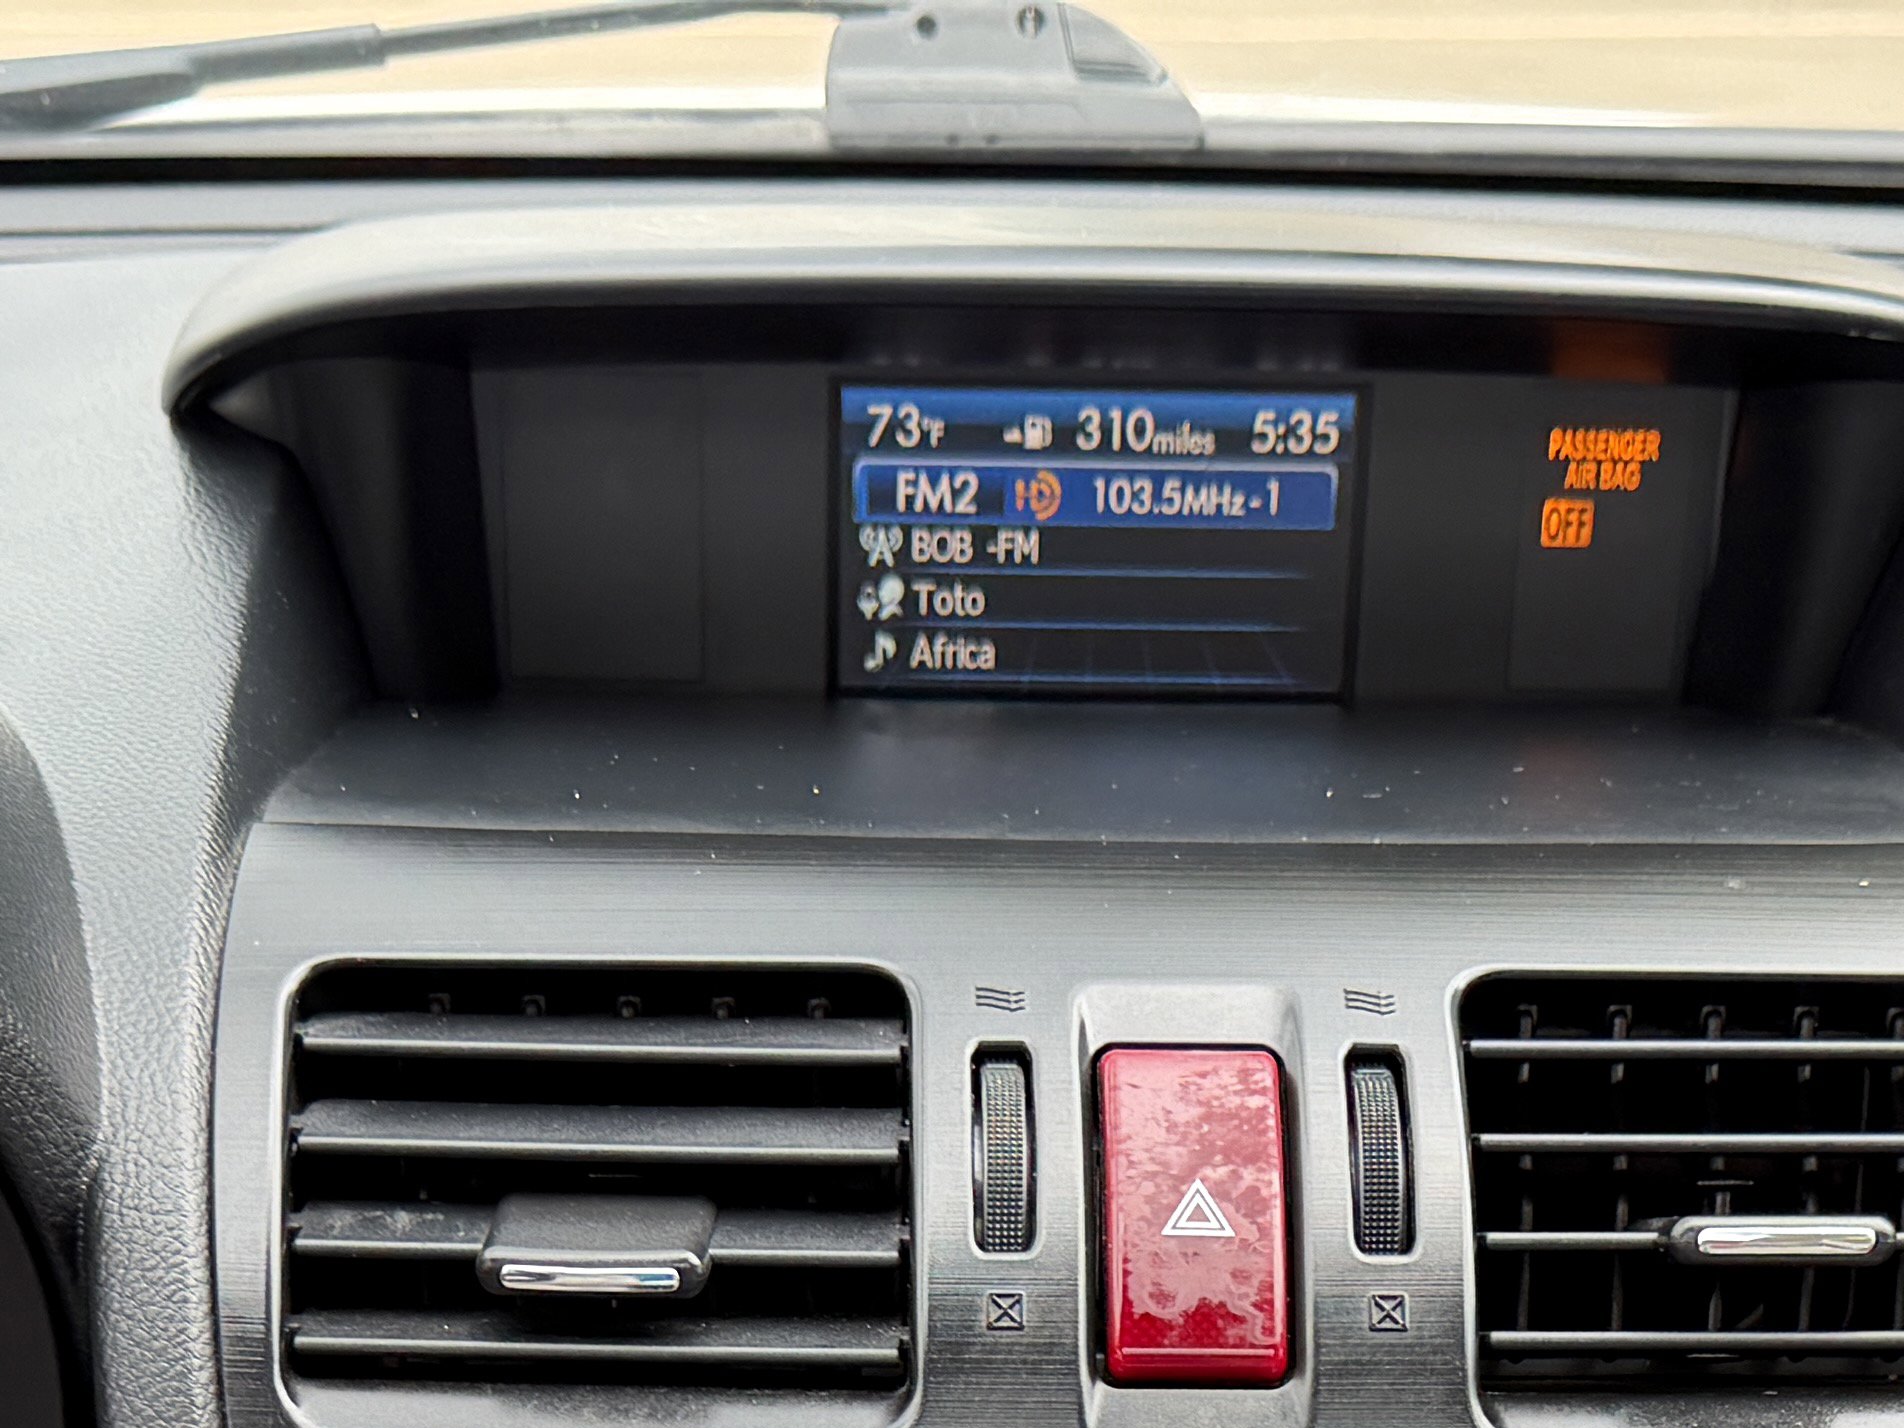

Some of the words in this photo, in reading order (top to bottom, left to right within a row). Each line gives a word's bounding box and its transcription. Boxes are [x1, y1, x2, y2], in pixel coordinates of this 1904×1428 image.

[1251, 410, 1339, 454] 5:35
[1548, 427, 1662, 462] PASSENGER
[896, 472, 978, 514] FM2
[1565, 461, 1596, 490] AIR
[1600, 461, 1641, 491] BAG
[911, 525, 973, 564] BOB
[1546, 506, 1588, 545] OFF
[911, 578, 985, 617] Toto
[910, 631, 996, 670] Africa
